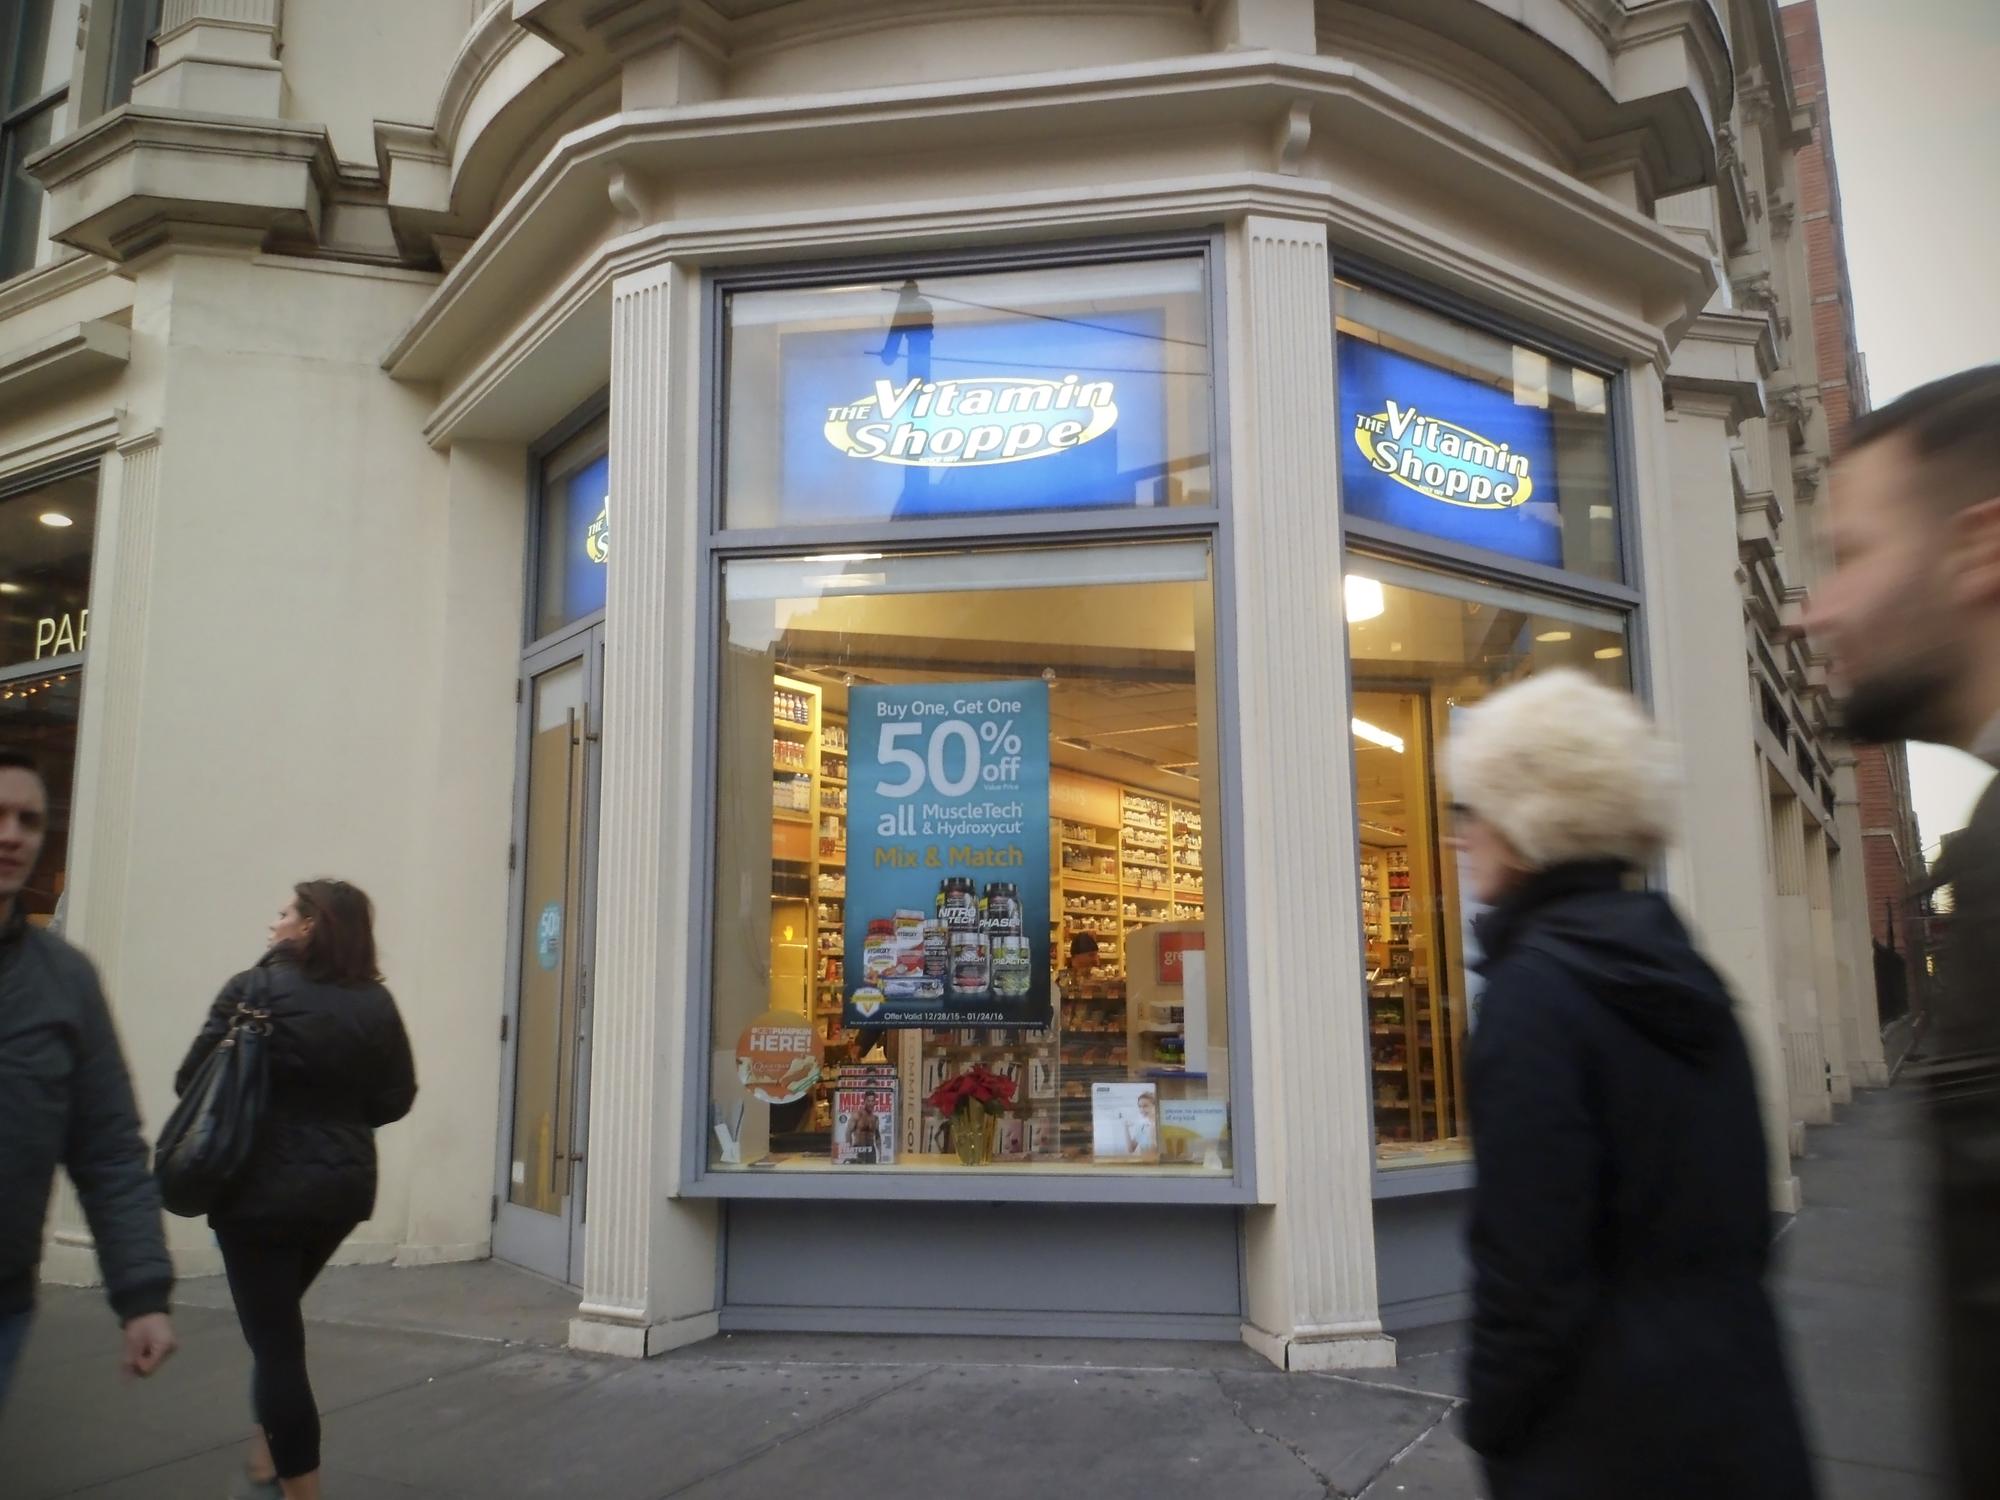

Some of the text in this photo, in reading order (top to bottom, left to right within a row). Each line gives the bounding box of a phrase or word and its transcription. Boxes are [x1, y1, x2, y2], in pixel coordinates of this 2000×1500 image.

[875, 374, 1114, 420] Vitamin
[827, 405, 872, 422] THE
[1356, 414, 1386, 434] THE
[848, 419, 1082, 459] Shoppe
[1385, 399, 1529, 477] Vitamin
[1371, 441, 1514, 507] Shoppe
[588, 519, 604, 537] THE
[877, 699, 1022, 720] Buy One, Get One
[875, 719, 1022, 798] 50%
[983, 757, 1021, 782] off
[877, 805, 916, 836] all
[922, 802, 1022, 820] MuscleTech
[922, 822, 1022, 838] & Hydroxycut
[875, 844, 1023, 869] Mix & Match
[938, 907, 977, 918] NITRO
[1164, 951, 1184, 966] gre
[924, 1012, 960, 1021] 12/28/15
[967, 1012, 1004, 1021] 01/24/16
[750, 1035, 812, 1052] HERE!
